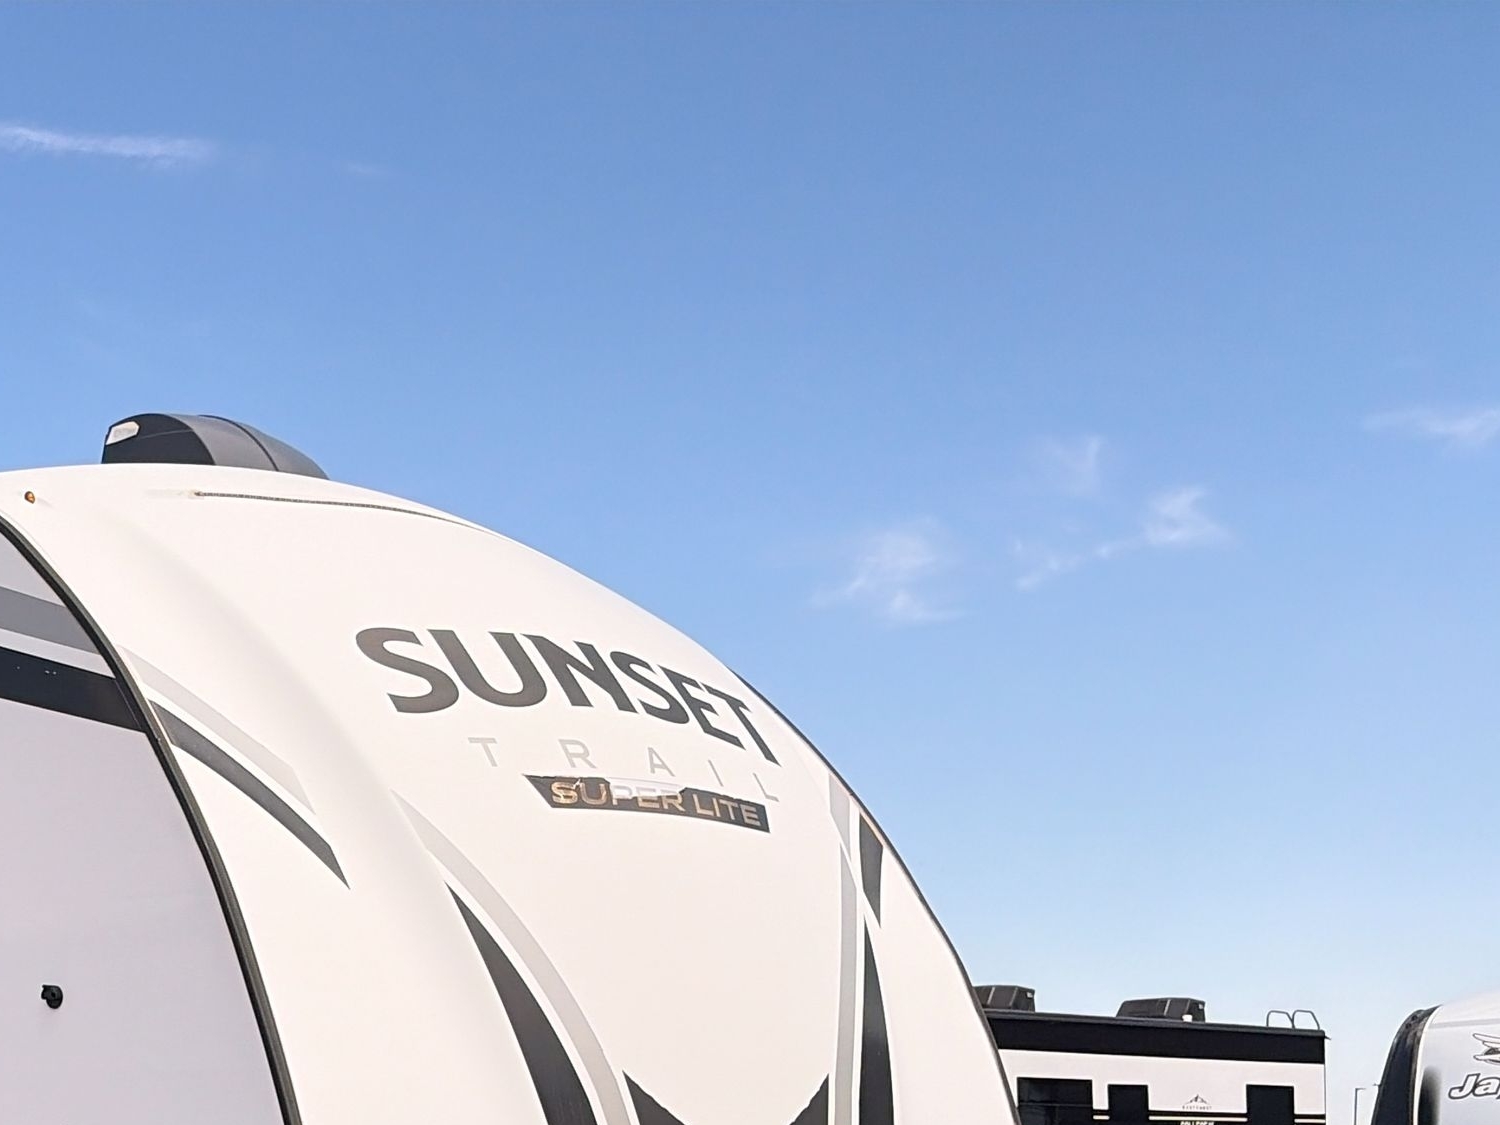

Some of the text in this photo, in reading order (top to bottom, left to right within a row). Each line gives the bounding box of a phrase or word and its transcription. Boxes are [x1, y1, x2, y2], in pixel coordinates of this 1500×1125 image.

[356, 627, 780, 767] SUNSET
[468, 736, 779, 803] TRAIL
[551, 781, 761, 827] SUPER LITE
[1448, 1073, 1500, 1100] Ja
